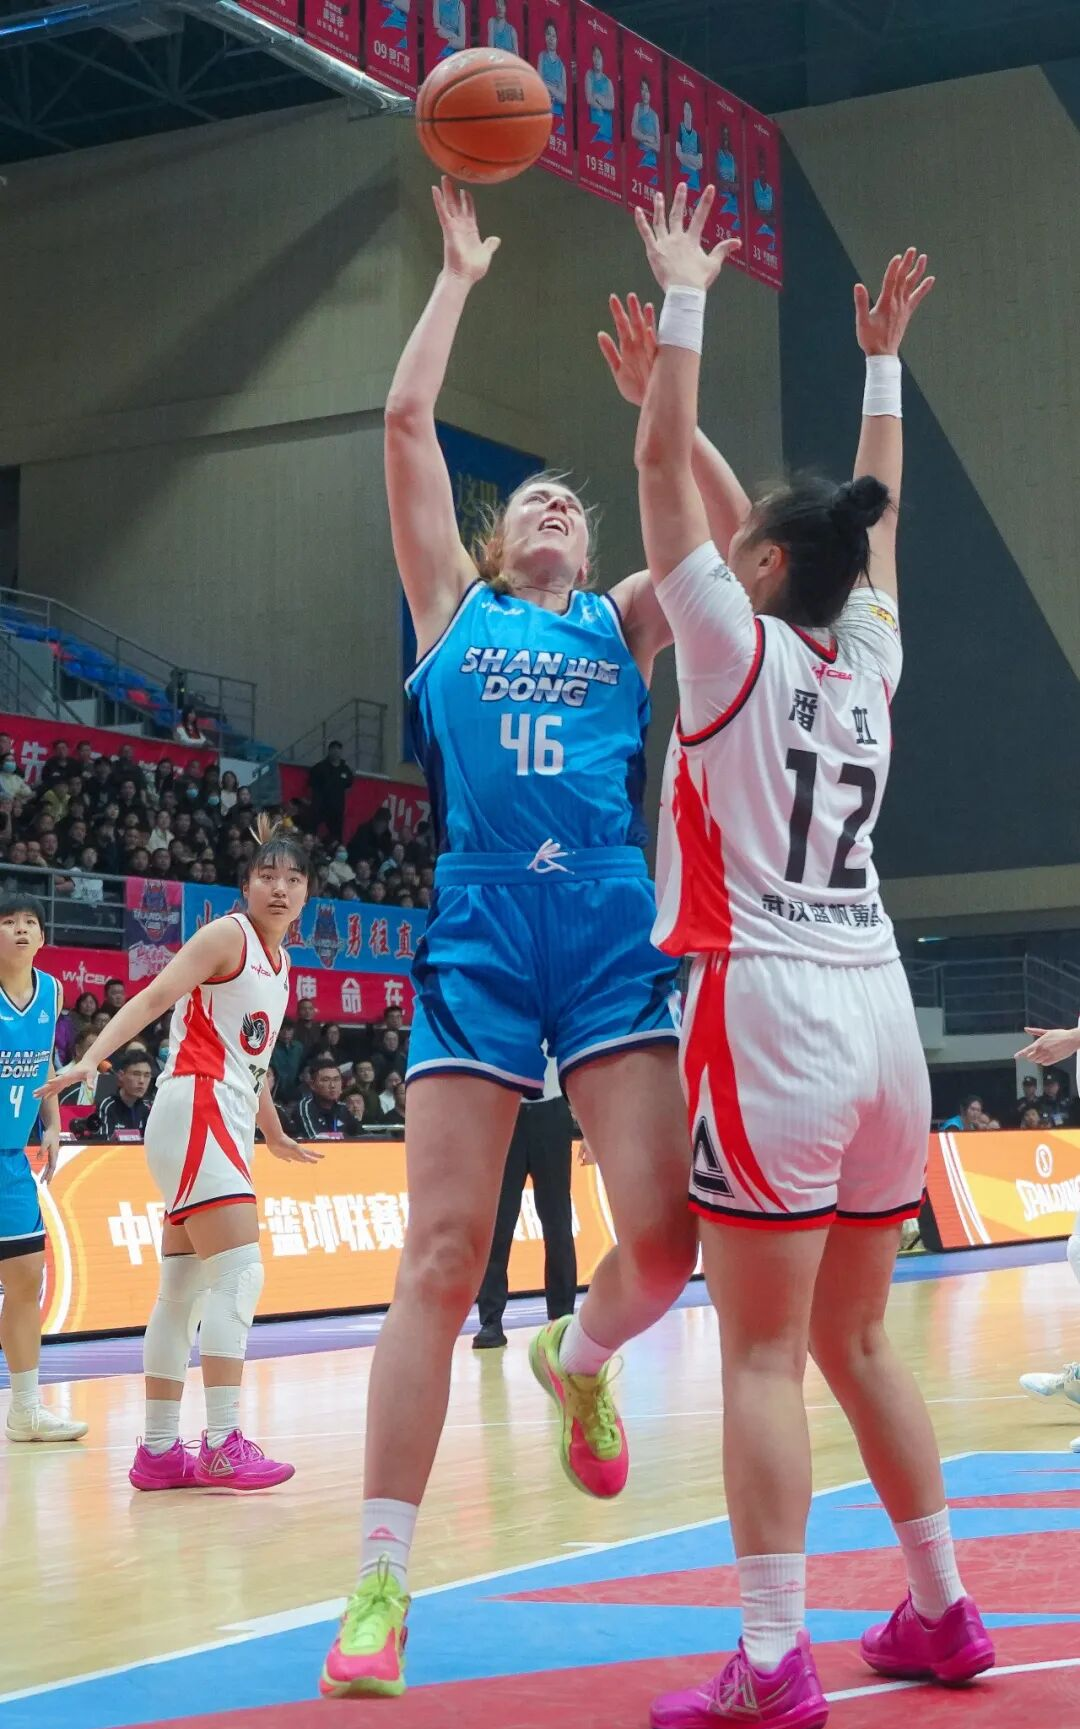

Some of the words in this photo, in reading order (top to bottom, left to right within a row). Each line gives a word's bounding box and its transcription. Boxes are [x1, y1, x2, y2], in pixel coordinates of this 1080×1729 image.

[374, 39, 387, 59] 09
[586, 154, 597, 171] 19
[631, 178, 642, 196] 21
[459, 646, 564, 675] SHAN
[480, 675, 588, 707] DONG
[500, 712, 564, 776] 46
[784, 747, 877, 889] 12
[345, 912, 424, 960] 勇往直
[1, 1064, 40, 1078] DONG
[9, 1085, 25, 1118] 4
[264, 1191, 409, 1257] 篮球联赛
